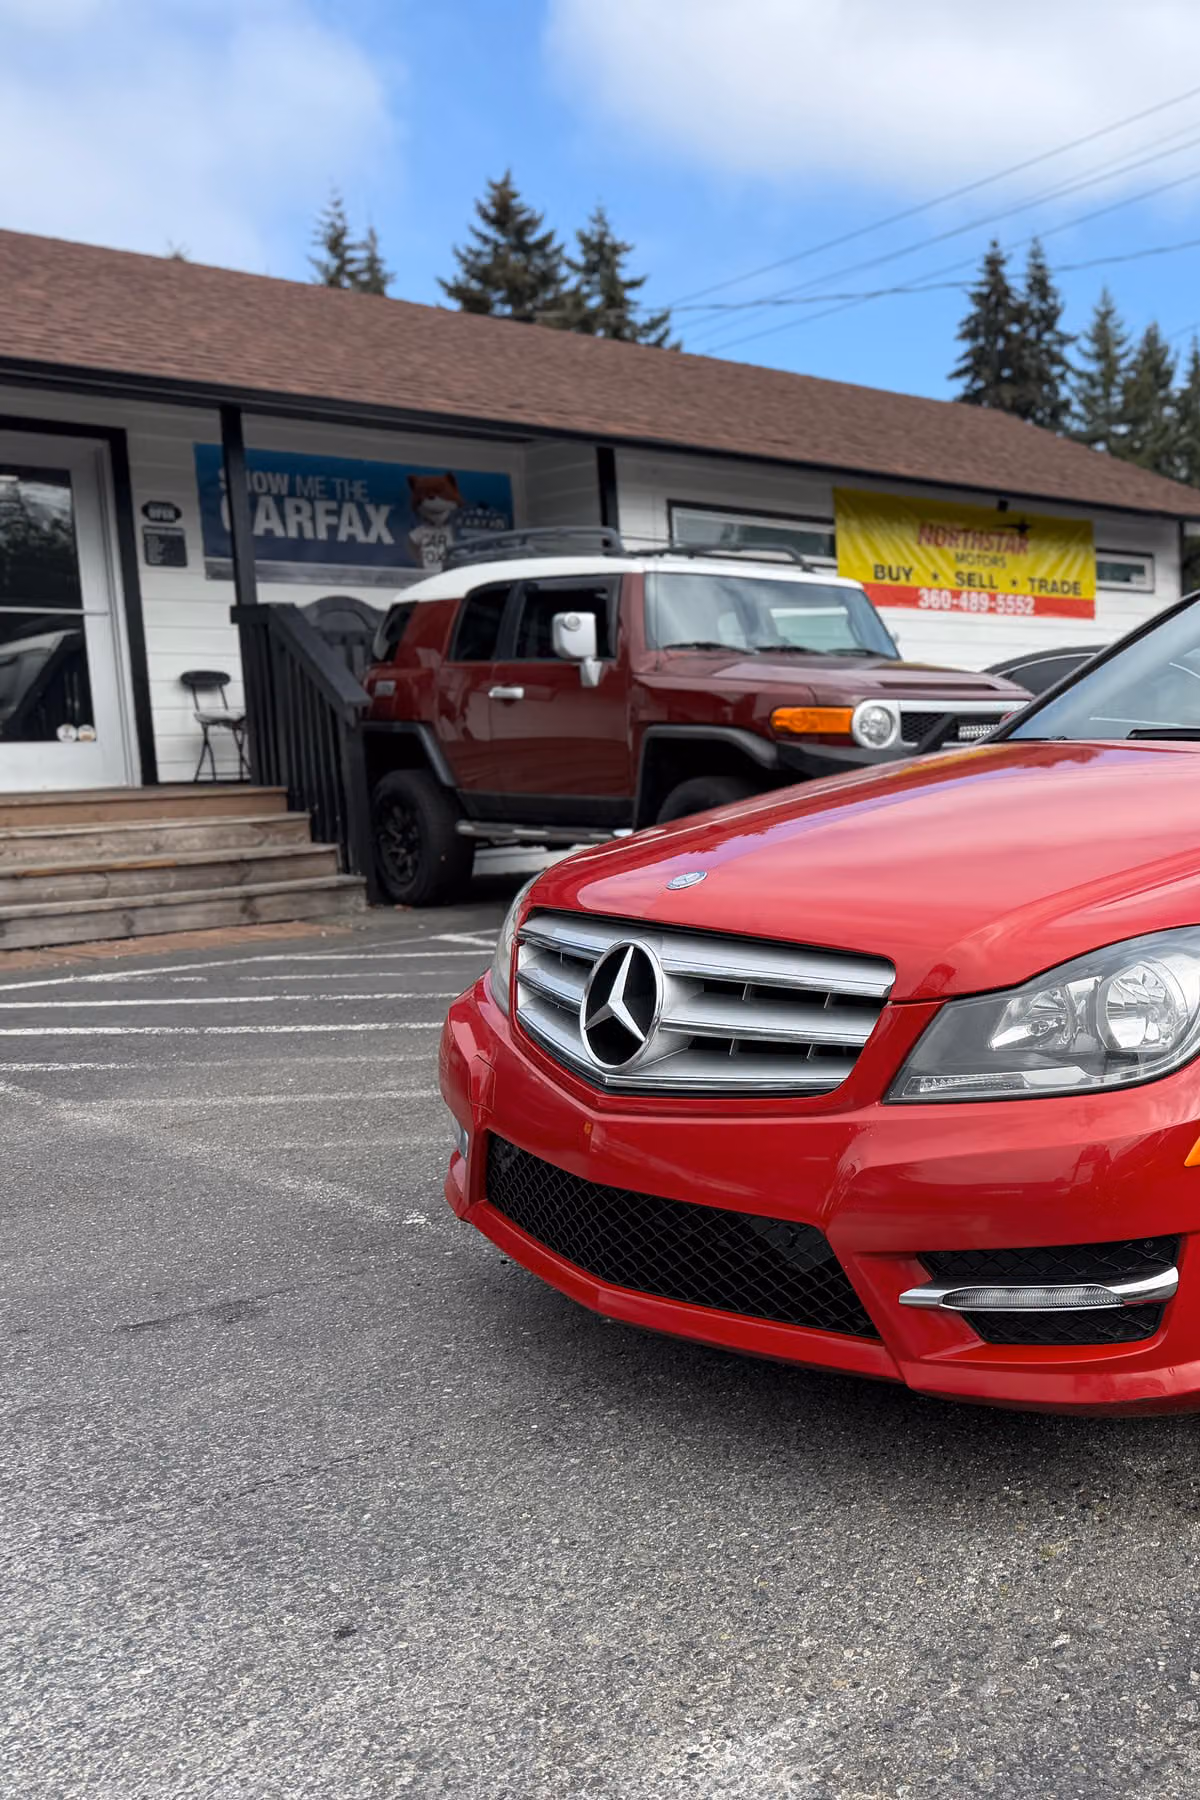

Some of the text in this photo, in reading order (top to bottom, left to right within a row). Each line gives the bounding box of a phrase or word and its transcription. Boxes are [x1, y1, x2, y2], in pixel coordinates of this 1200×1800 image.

[296, 474, 327, 499] ME
[334, 477, 369, 503] THE
[917, 523, 1030, 556] NORTHSTAR
[955, 552, 1007, 569] MOTORS
[873, 564, 1083, 595] BUY SELL TRADE
[918, 588, 1036, 615] 360-489-5552
